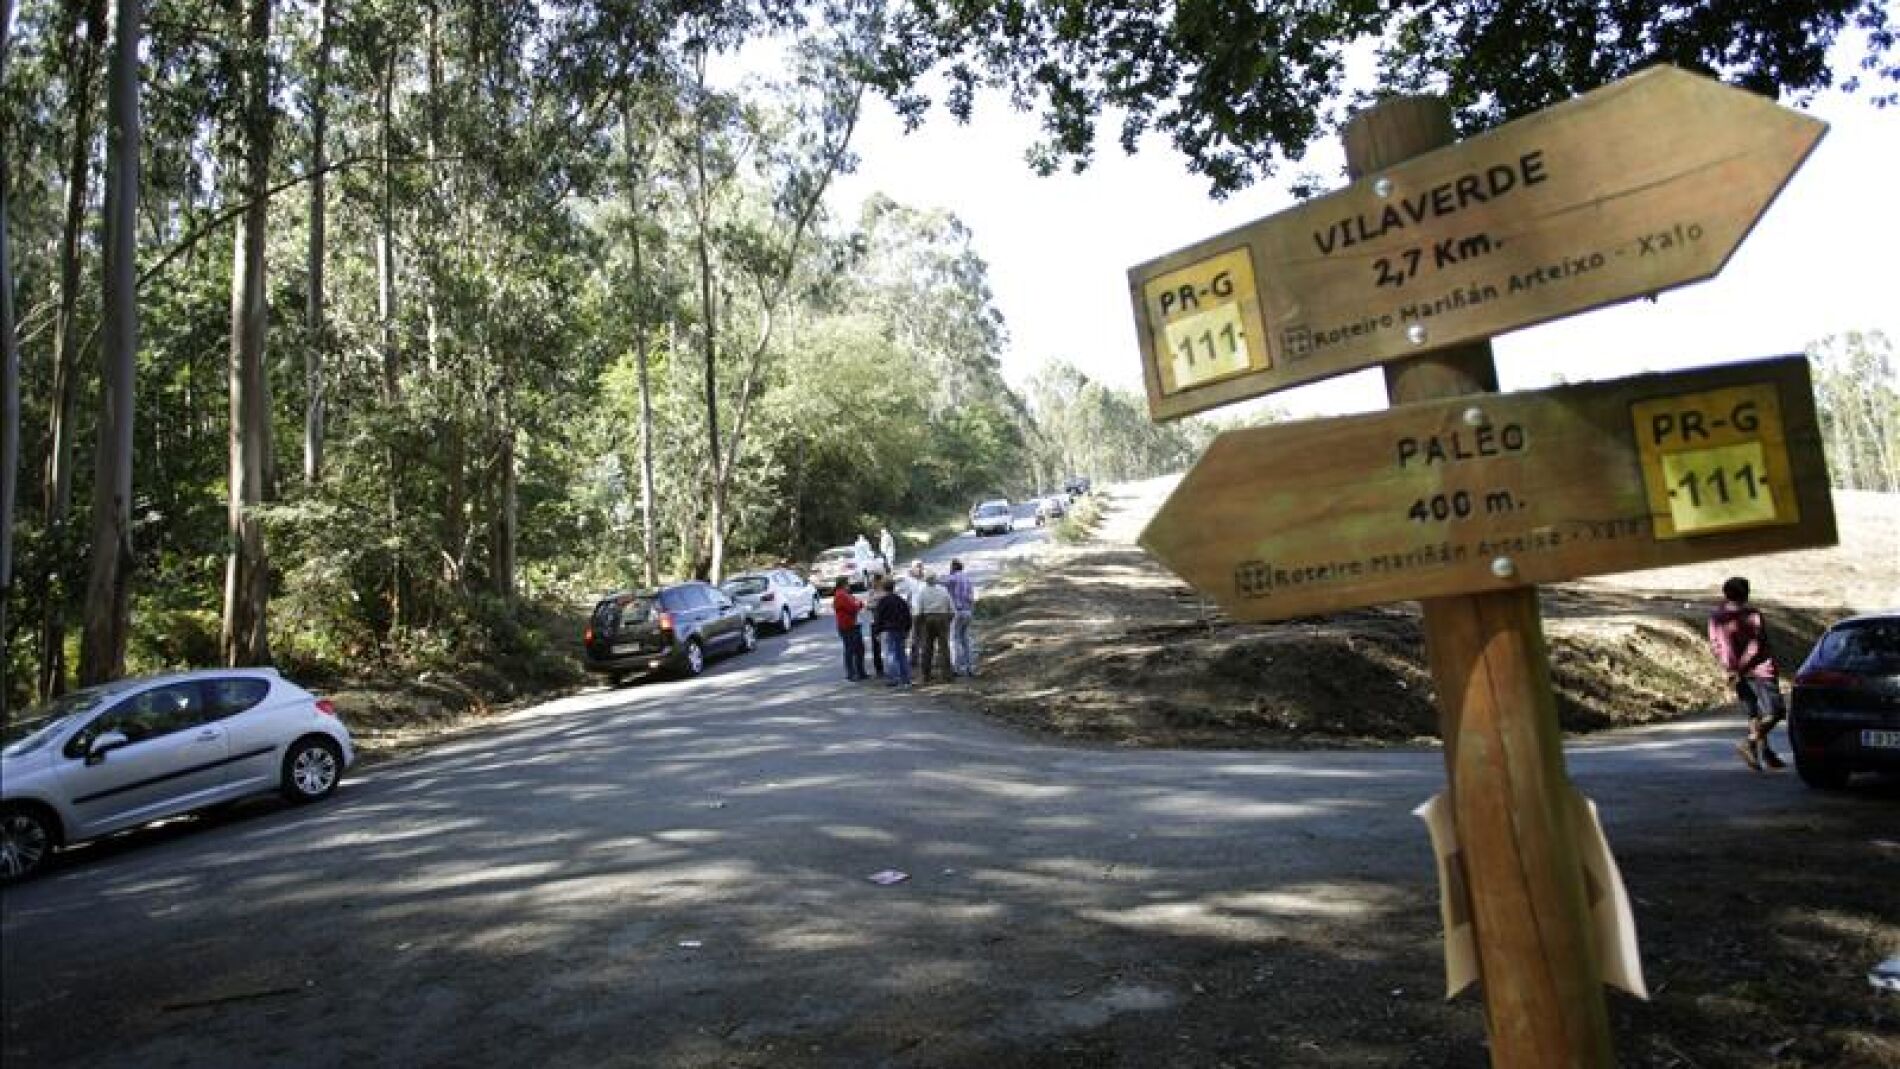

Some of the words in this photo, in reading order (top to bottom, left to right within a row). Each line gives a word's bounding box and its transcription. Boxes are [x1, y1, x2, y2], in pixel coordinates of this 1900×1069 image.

[1312, 149, 1548, 256] VILAVERDE
[1373, 248, 1423, 288] 2,7
[1434, 232, 1504, 270] Km.
[1160, 269, 1234, 317] PR-G
[1314, 314, 1394, 349] Roteiro
[1401, 280, 1499, 323] Mariñán
[1508, 251, 1606, 294] Arteixo
[1637, 221, 1704, 258] Xalo
[1397, 423, 1525, 470] PALEO
[1652, 401, 1760, 446] PR-G
[1408, 489, 1472, 523] 400
[1486, 489, 1526, 514] m.
[1274, 560, 1363, 586] Roteiro
